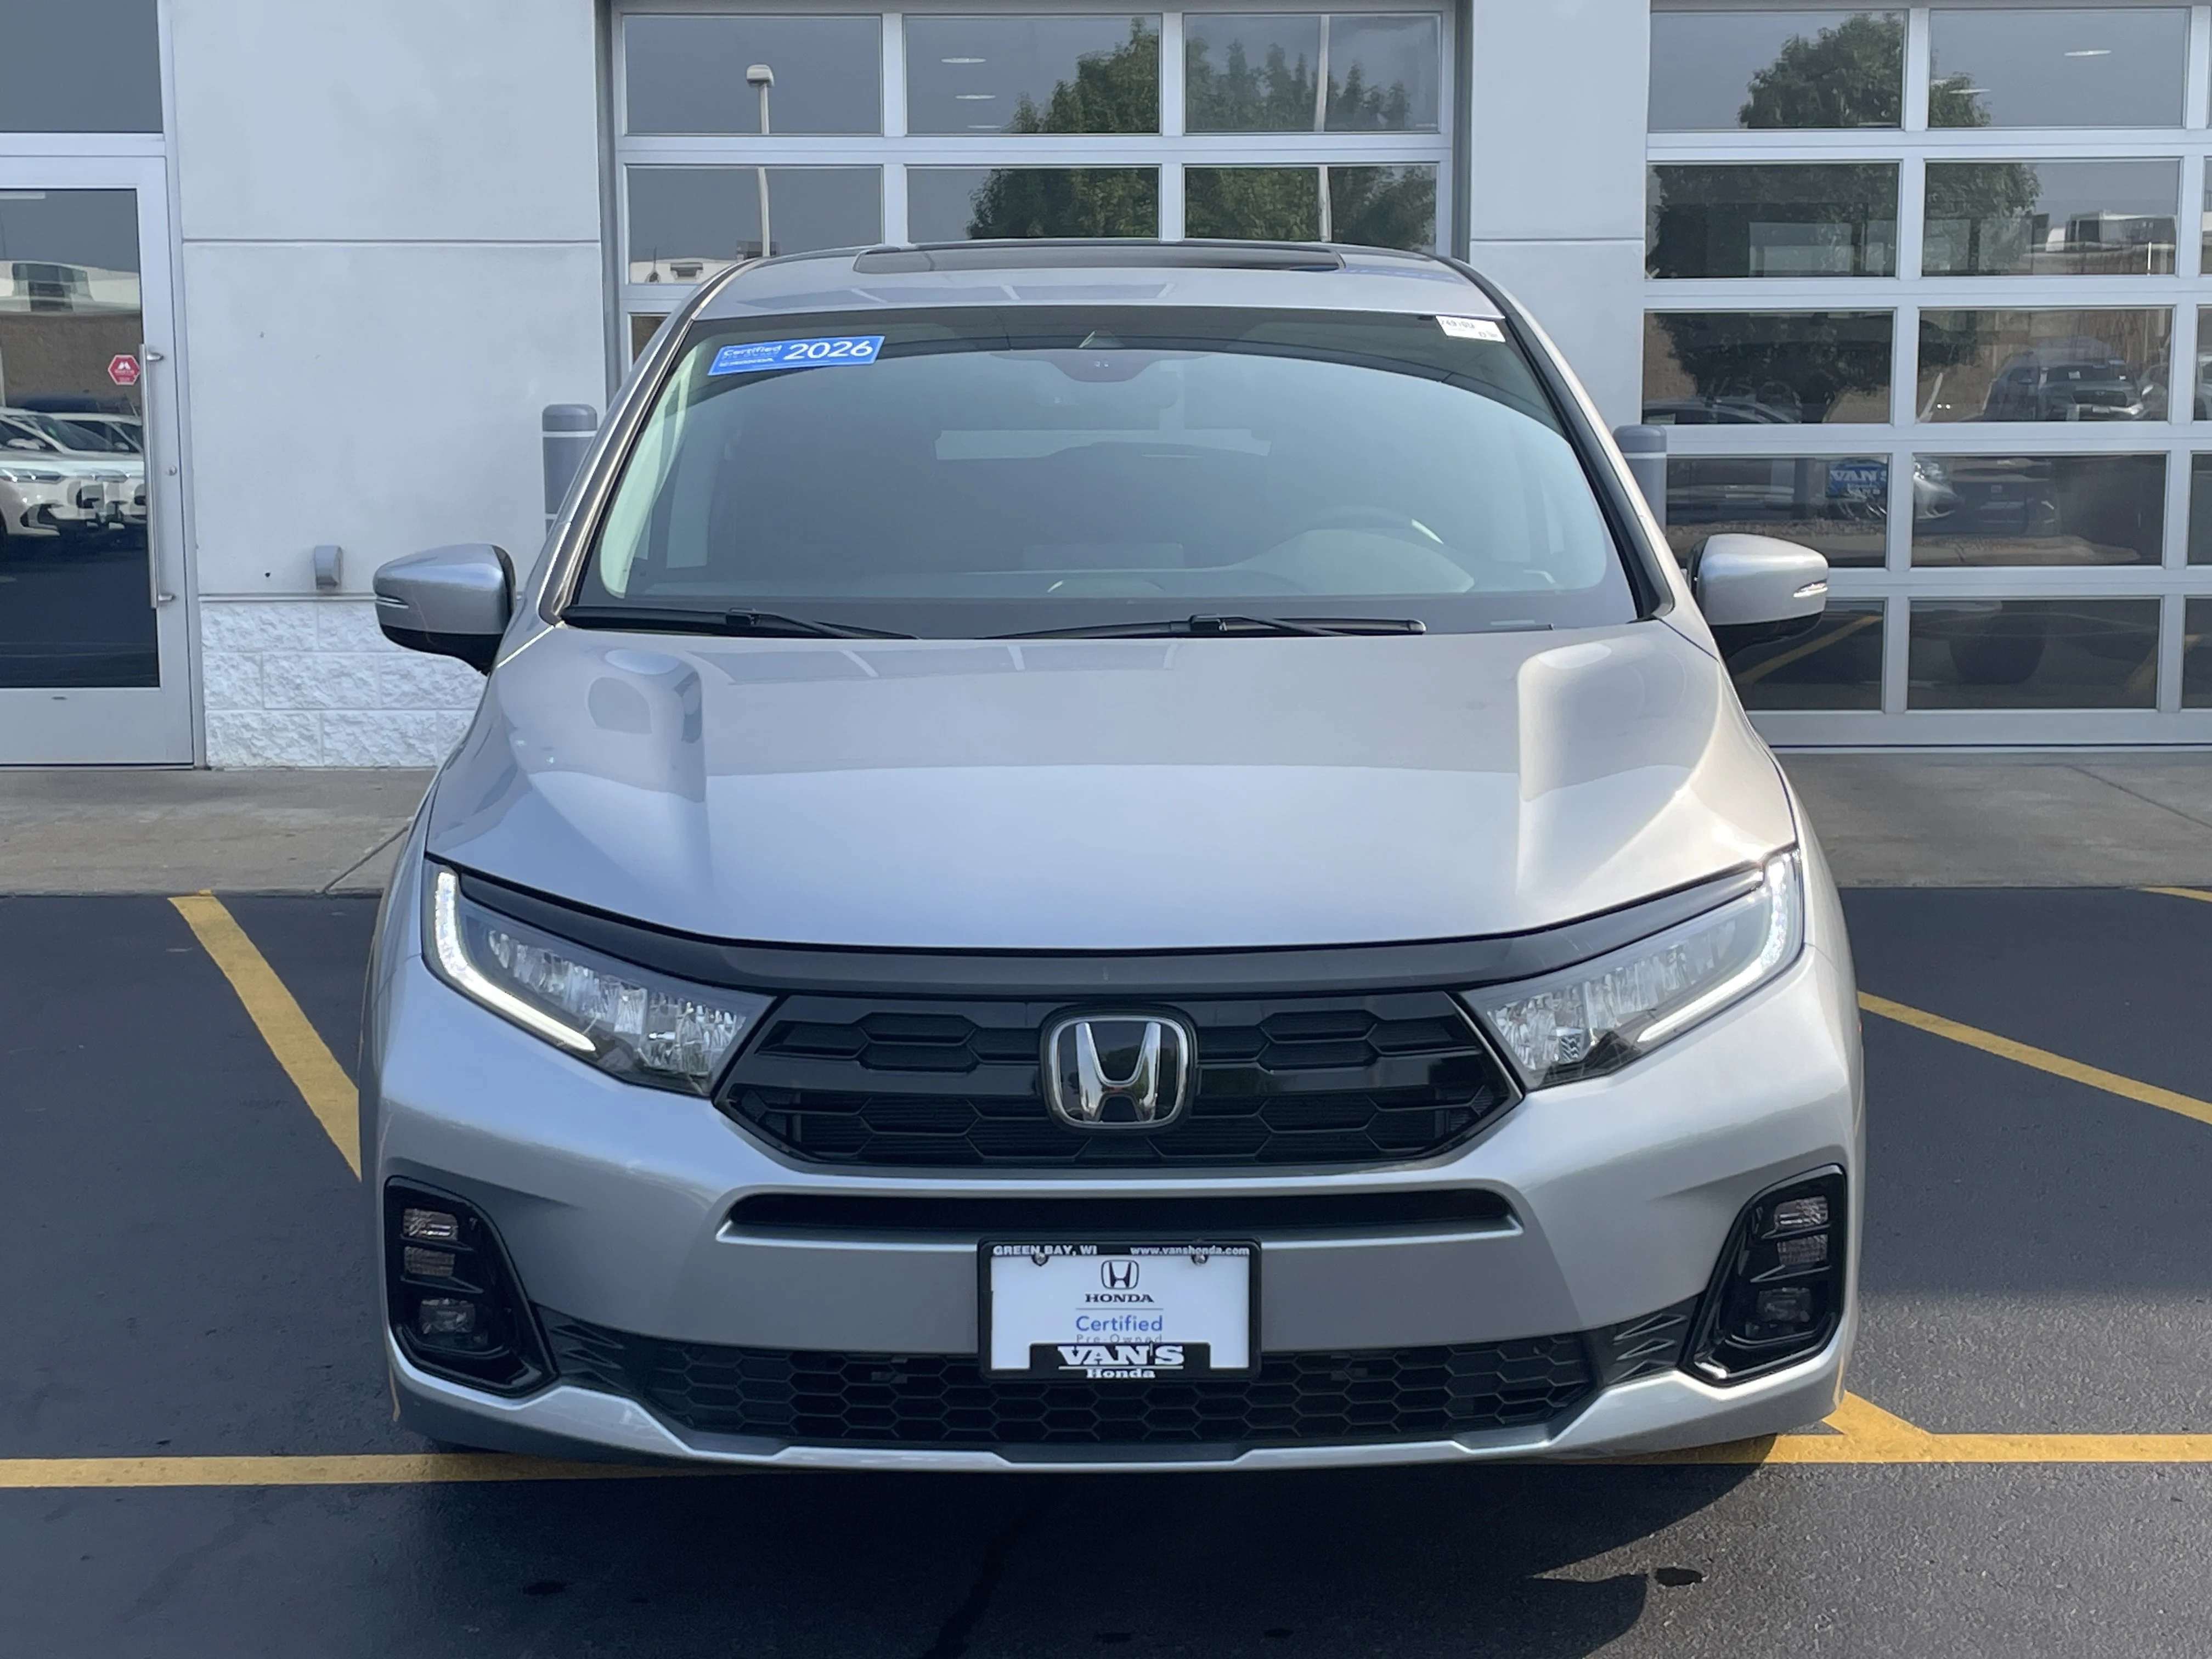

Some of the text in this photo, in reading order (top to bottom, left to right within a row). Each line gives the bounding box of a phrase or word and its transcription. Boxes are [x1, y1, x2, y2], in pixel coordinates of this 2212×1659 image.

[724, 344, 782, 356] Certified
[783, 340, 873, 360] 2026
[992, 1244, 1098, 1256] GREEN BAY, WI
[1130, 1244, 1250, 1255] www.vanshonda.com
[1085, 1293, 1154, 1303] HONDA
[1075, 1315, 1163, 1331] Certified
[1076, 1333, 1163, 1343] Pre-Owned
[1057, 1342, 1185, 1365] VAN'S
[1086, 1368, 1156, 1379] Honda
